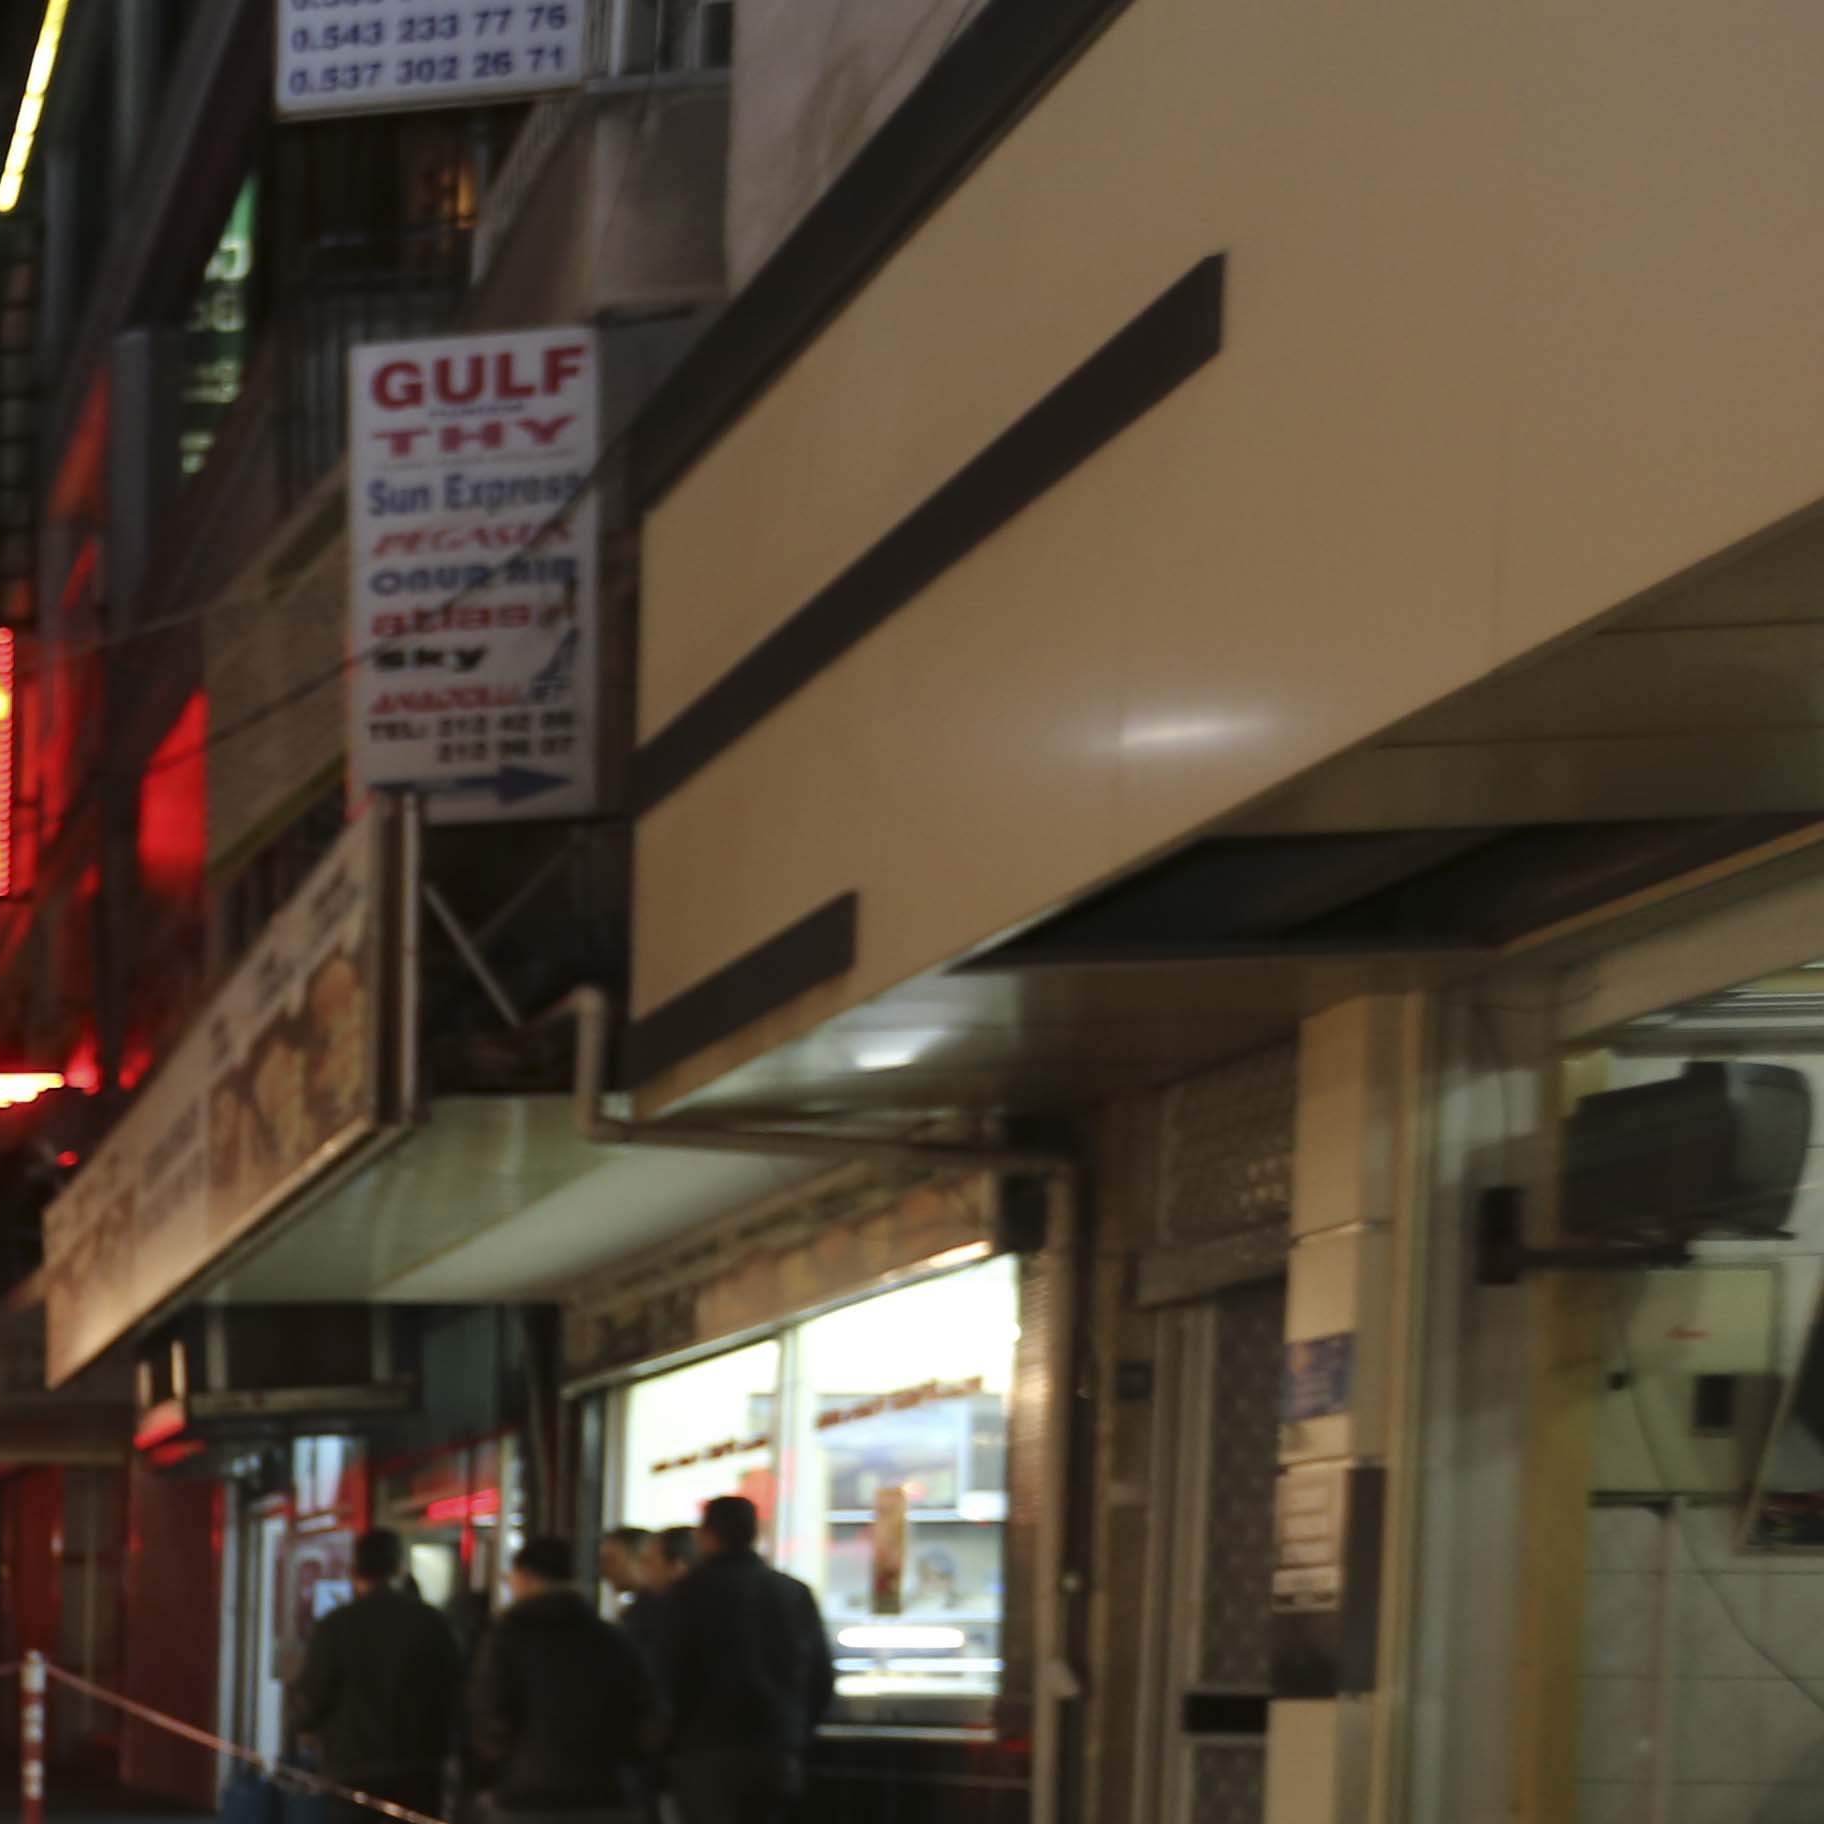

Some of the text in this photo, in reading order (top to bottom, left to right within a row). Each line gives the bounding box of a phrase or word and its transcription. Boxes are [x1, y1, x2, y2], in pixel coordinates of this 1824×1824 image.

[473, 8, 512, 36] 77
[526, 46, 564, 71] 71
[371, 346, 586, 412] GULF
[371, 414, 578, 458] THY
[368, 479, 430, 516] Sun
